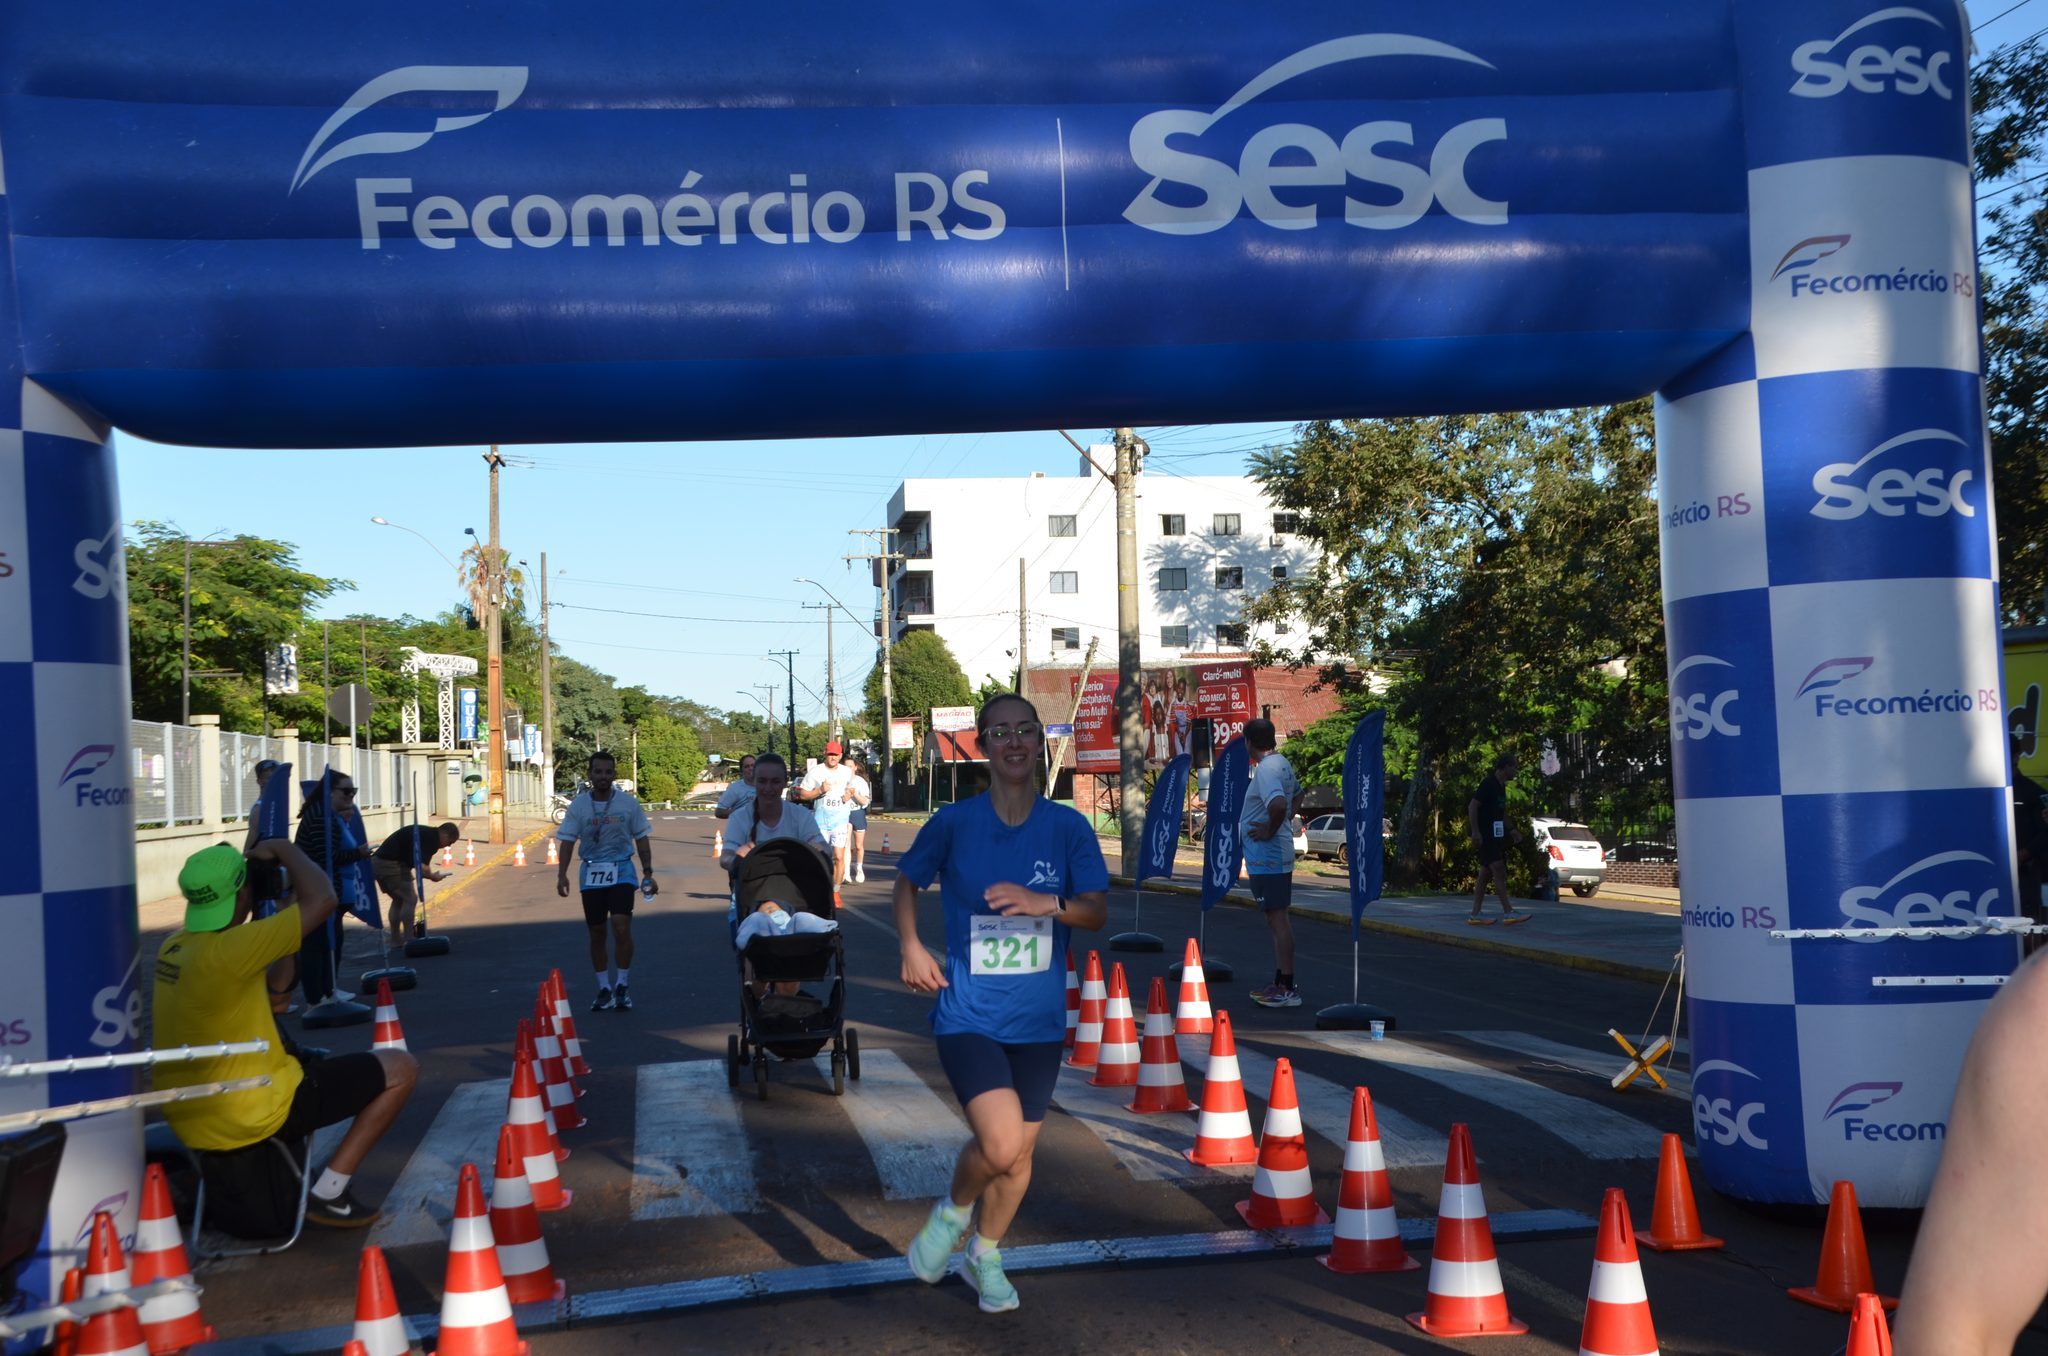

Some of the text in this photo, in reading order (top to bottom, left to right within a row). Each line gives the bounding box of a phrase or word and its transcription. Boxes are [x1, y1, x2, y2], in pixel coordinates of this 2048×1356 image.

[1789, 40, 1952, 100] Sesc
[1122, 108, 1509, 235] Sesc
[356, 169, 1007, 250] Fecomércio RS
[1791, 267, 1973, 298] Fecomércio RS
[1717, 493, 1751, 517] RS
[1809, 462, 1975, 521] Sesc
[1211, 692, 1226, 702] MEGA
[1231, 692, 1240, 701] 60
[1815, 688, 1998, 717] Fecomércio RS
[465, 705, 476, 740] URI
[1152, 820, 1170, 869] Sesc
[1213, 823, 1233, 888] Sesc
[591, 871, 613, 884] 774
[1682, 904, 1777, 929] mércio RS
[982, 936, 1038, 969] 321
[1694, 1093, 1769, 1150] esc
